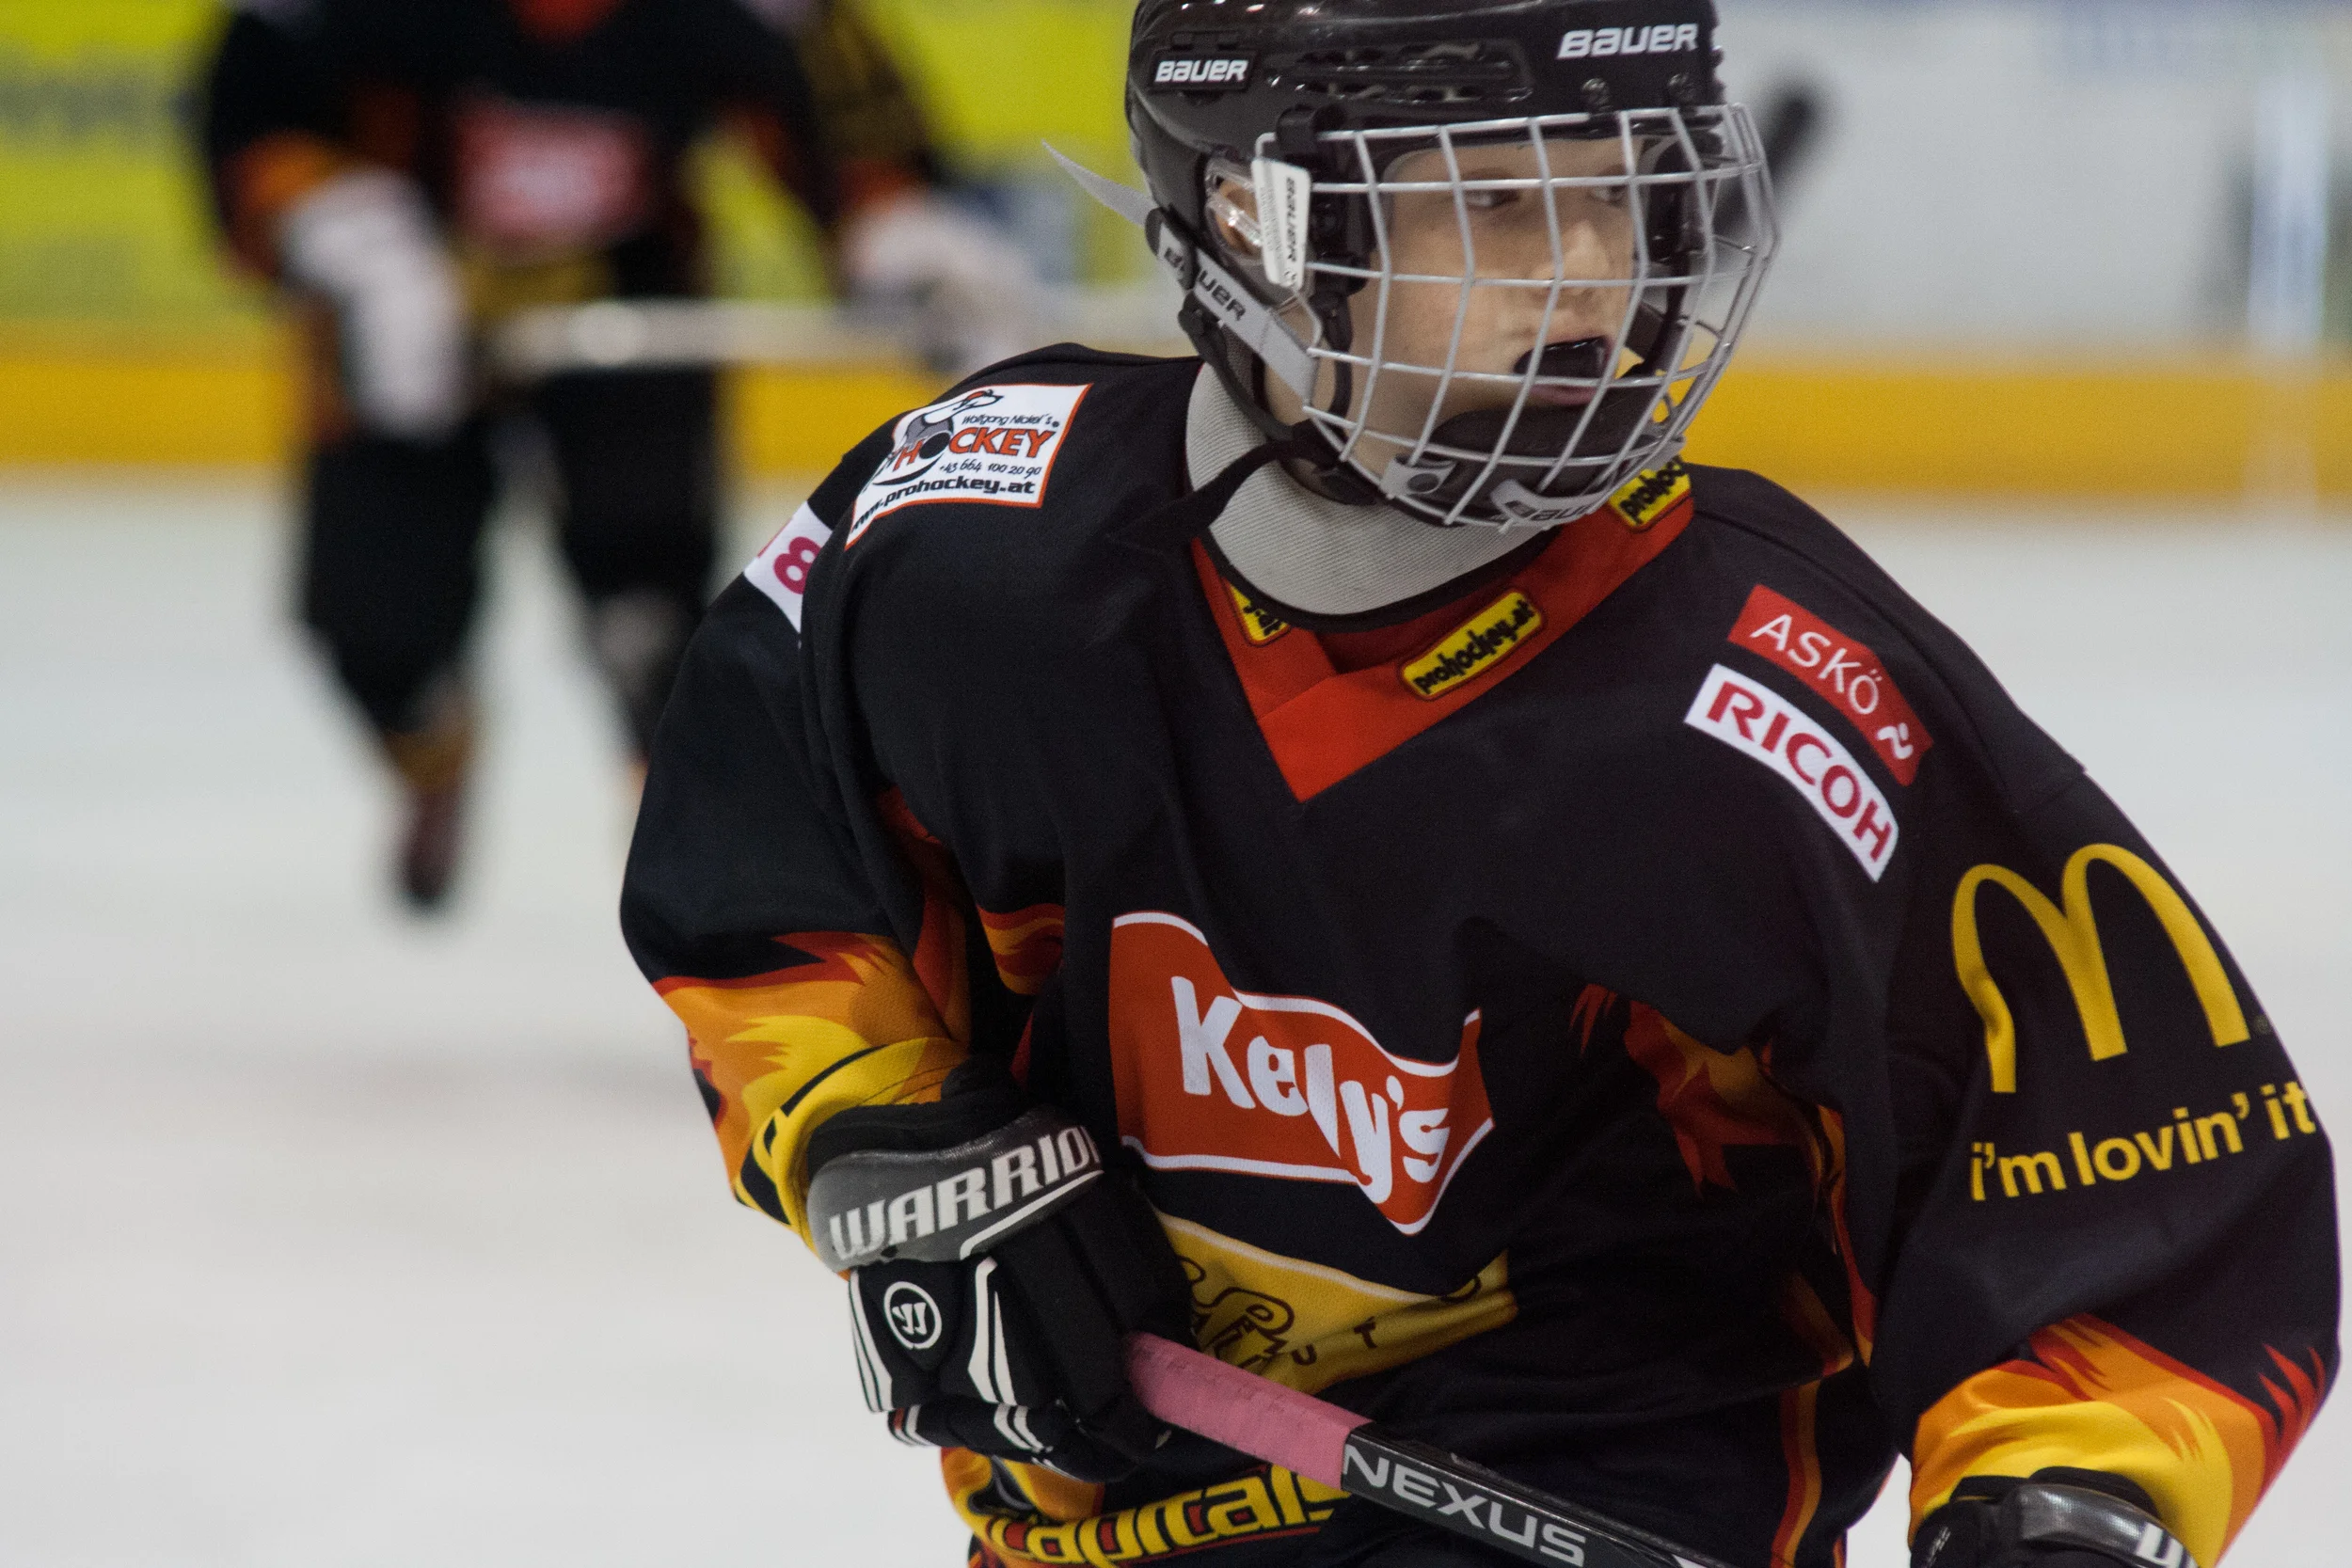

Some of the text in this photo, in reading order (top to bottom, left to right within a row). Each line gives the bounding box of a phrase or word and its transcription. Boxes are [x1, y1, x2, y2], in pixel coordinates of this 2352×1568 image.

[1154, 59, 1249, 83] BAUER
[1555, 24, 1698, 60] BAUER
[1164, 247, 1247, 321] BUER
[960, 458, 982, 473] 664
[988, 462, 1008, 473] 100
[1008, 466, 1025, 475] 20
[1413, 599, 1535, 694] prohockey.at
[1750, 614, 1883, 715] ASKÖ
[1706, 680, 1892, 863] RICOH
[1970, 1081, 2316, 1202] i'm lovin' it
[829, 1125, 1101, 1260] WARRIO
[1343, 1443, 1586, 1568] NEXUS
